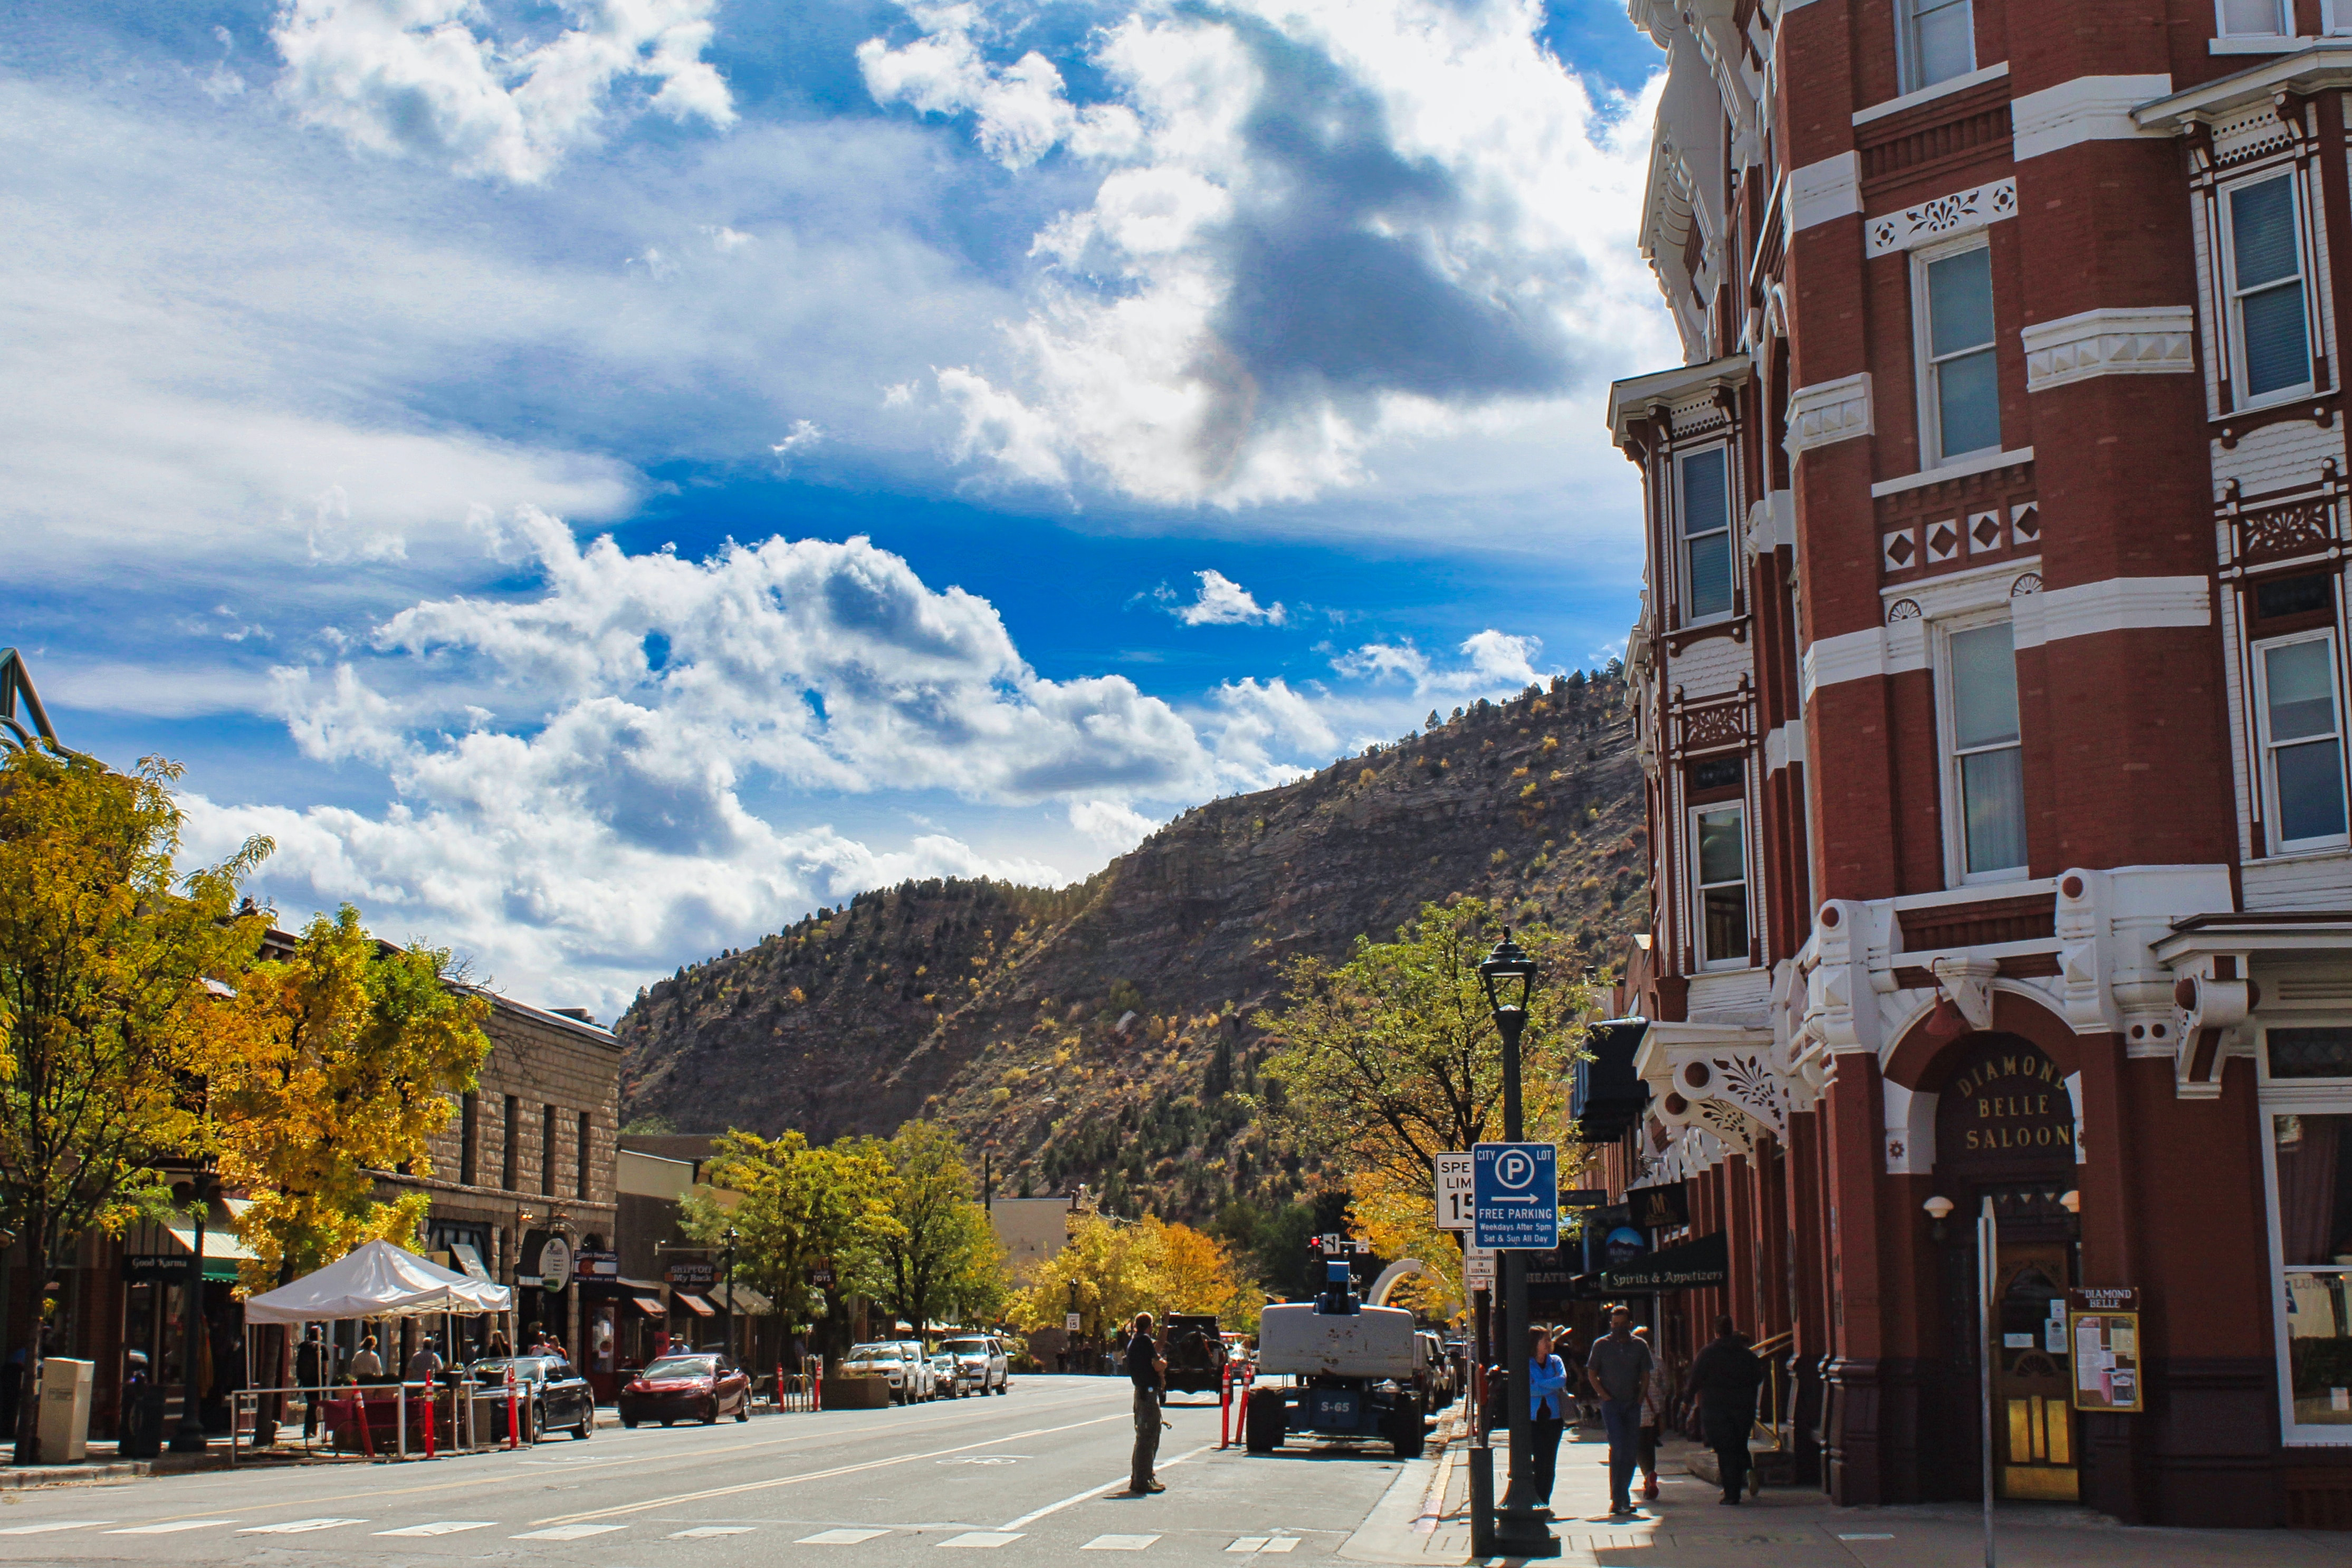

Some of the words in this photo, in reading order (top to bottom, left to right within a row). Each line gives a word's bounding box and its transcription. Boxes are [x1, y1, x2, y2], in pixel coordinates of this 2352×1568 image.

[1979, 1095, 2050, 1118] BELLE
[1966, 1125, 2071, 1150] SALOON
[1477, 1151, 1496, 1161] CITY
[1536, 1150, 1552, 1161] LOT
[1441, 1162, 1470, 1173] SPE
[1447, 1178, 1471, 1189] LIM
[1450, 1193, 1473, 1220] 15
[1479, 1209, 1504, 1219] FREE
[1508, 1209, 1552, 1219] PARKING
[1534, 1235, 1548, 1244] Day
[132, 1257, 155, 1269] Good
[157, 1257, 187, 1269] Karma
[673, 1274, 689, 1283] My
[1526, 1272, 1575, 1283] HEATR
[1612, 1274, 1649, 1287] Spirits
[1651, 1272, 1661, 1284] &
[1663, 1270, 1724, 1284] Appetizers
[2085, 1289, 2132, 1299] DIAMOND
[2089, 1298, 2121, 1308] BELLE
[1321, 1401, 1350, 1413] S-65
